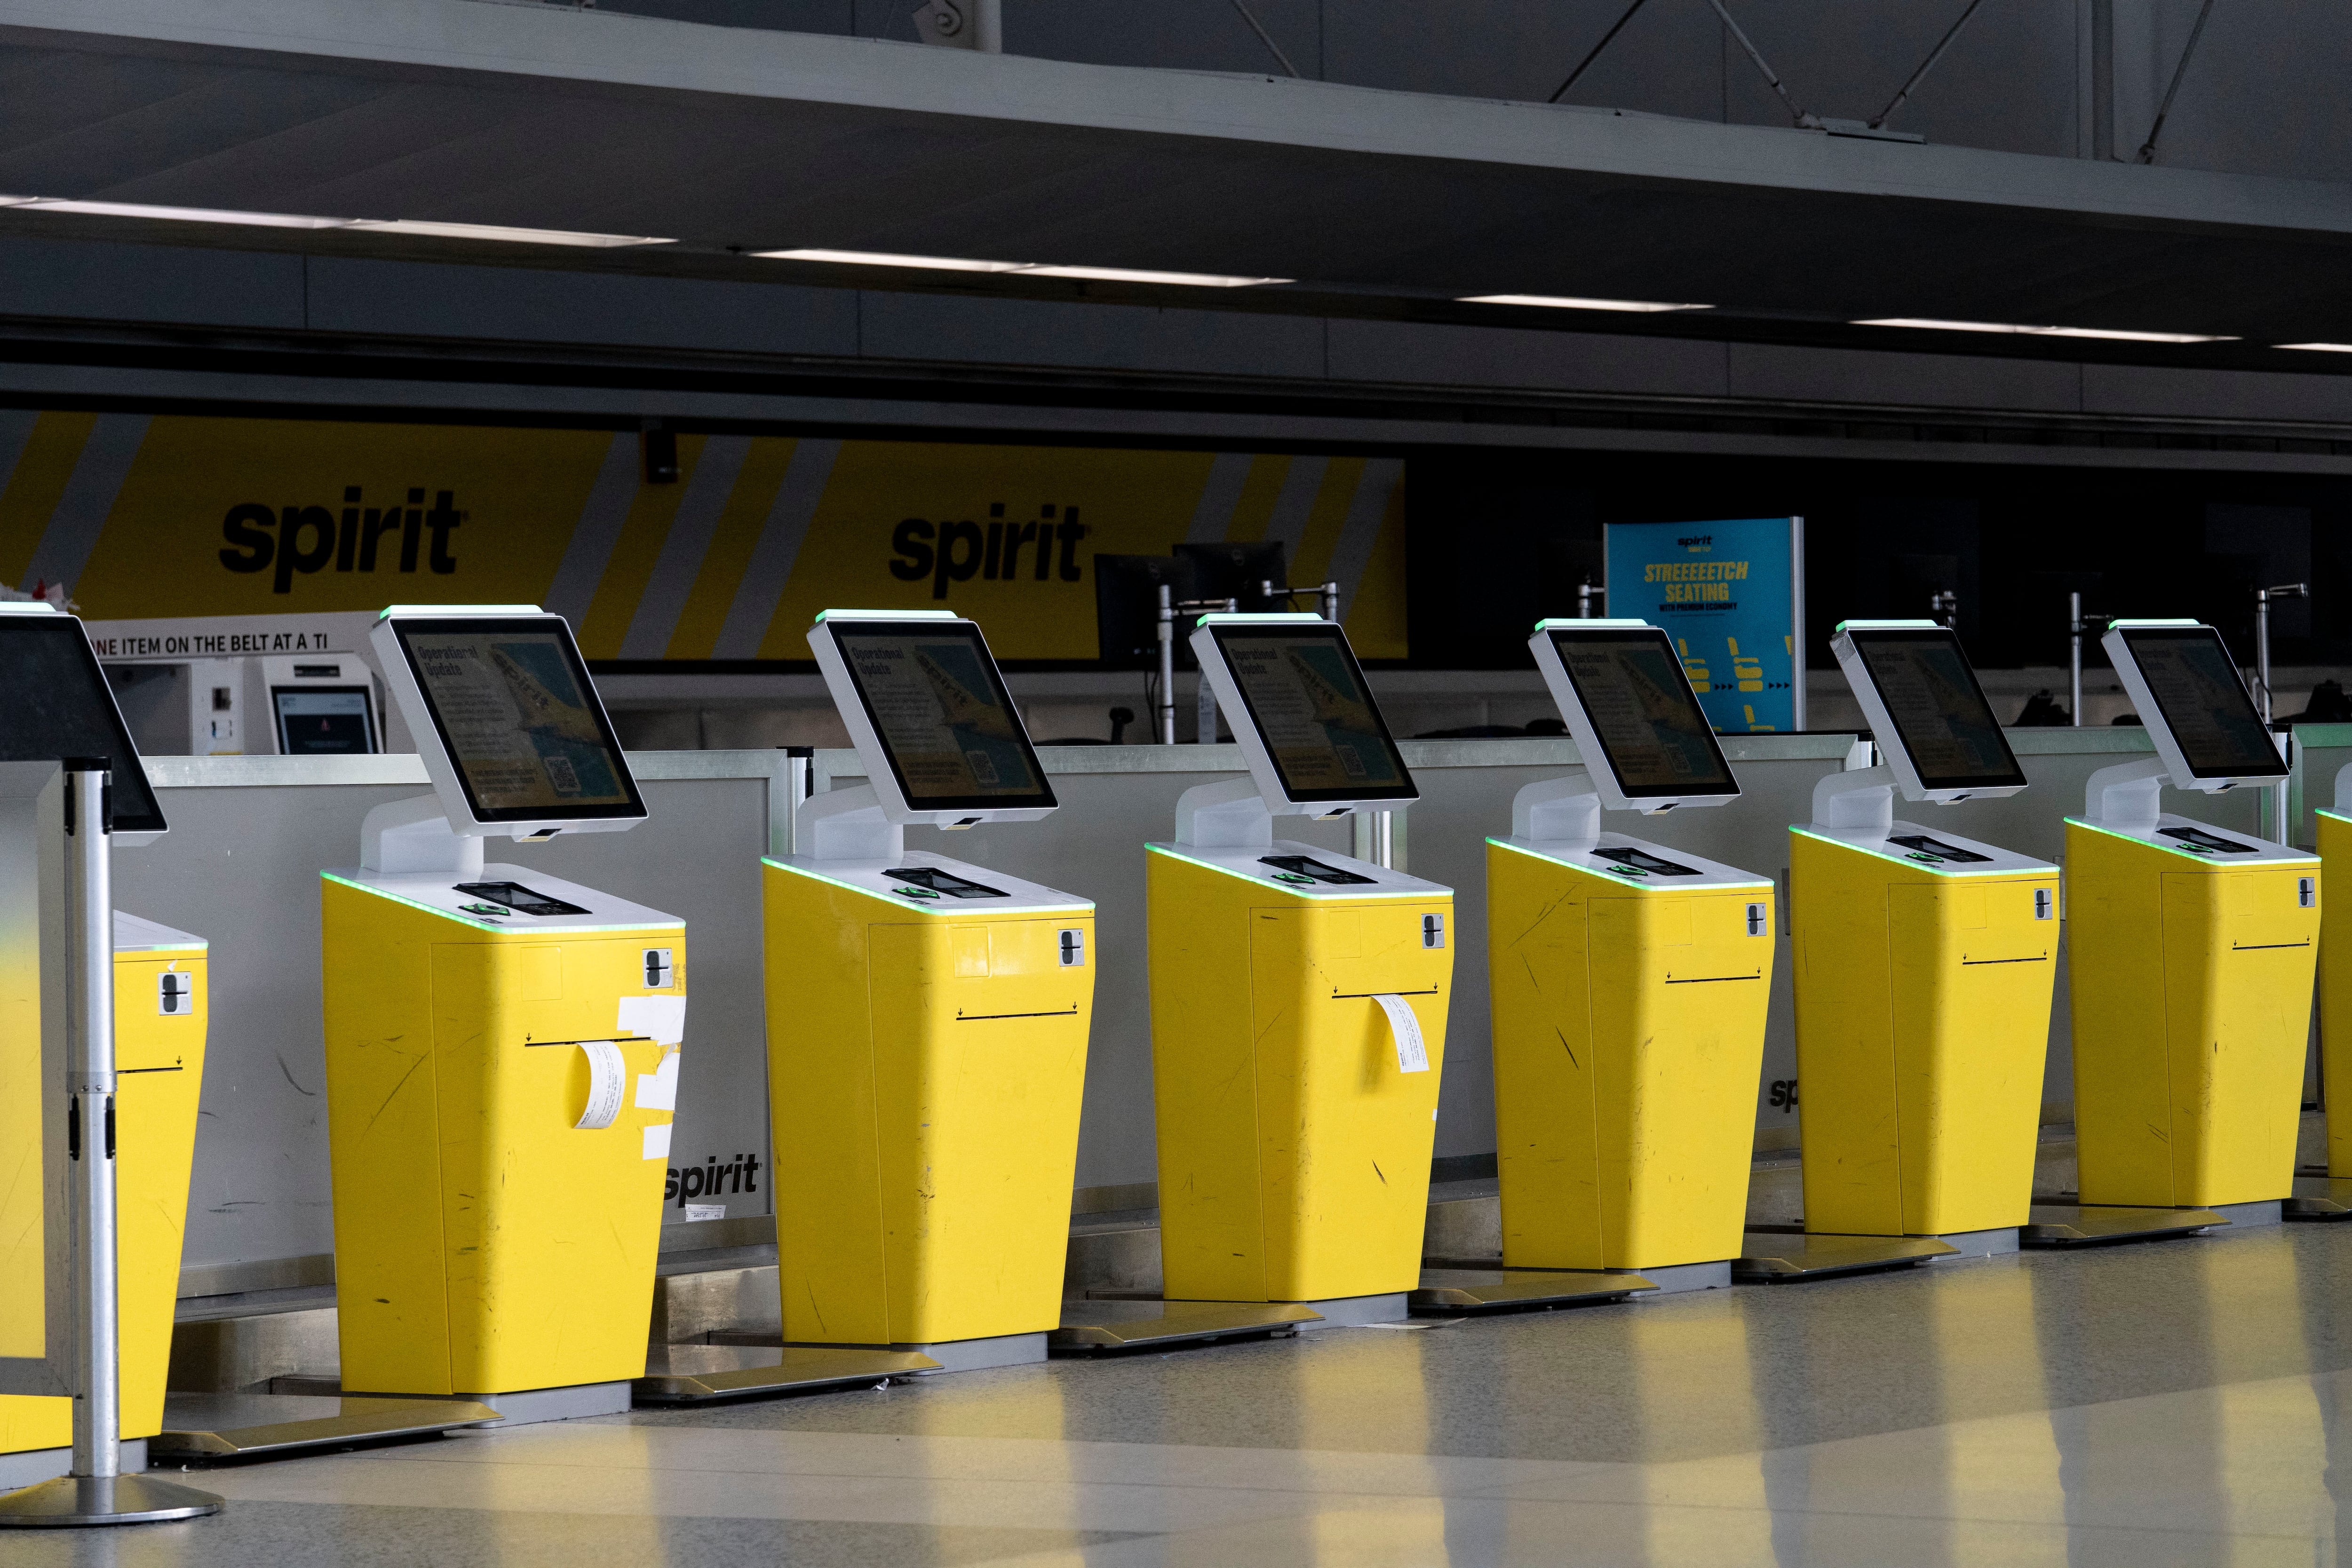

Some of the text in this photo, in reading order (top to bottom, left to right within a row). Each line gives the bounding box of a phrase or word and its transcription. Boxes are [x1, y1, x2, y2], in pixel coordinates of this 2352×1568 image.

[219, 486, 461, 594] spirit
[1678, 535, 1712, 547] spirit
[889, 502, 1085, 599] spirit
[1645, 561, 1748, 582] STREEEEETCH
[1665, 582, 1729, 602] SEATING
[91, 638, 117, 655] NE
[122, 637, 160, 654] ITEM
[166, 637, 188, 653] ON
[194, 636, 226, 652] THE
[231, 634, 269, 651] BELT
[273, 634, 292, 650] AT
[297, 633, 307, 649] A
[418, 645, 479, 662] Operational
[851, 646, 904, 661] Operational
[424, 662, 462, 679] Update
[858, 662, 891, 677] Update
[664, 1154, 759, 1208] spirit
